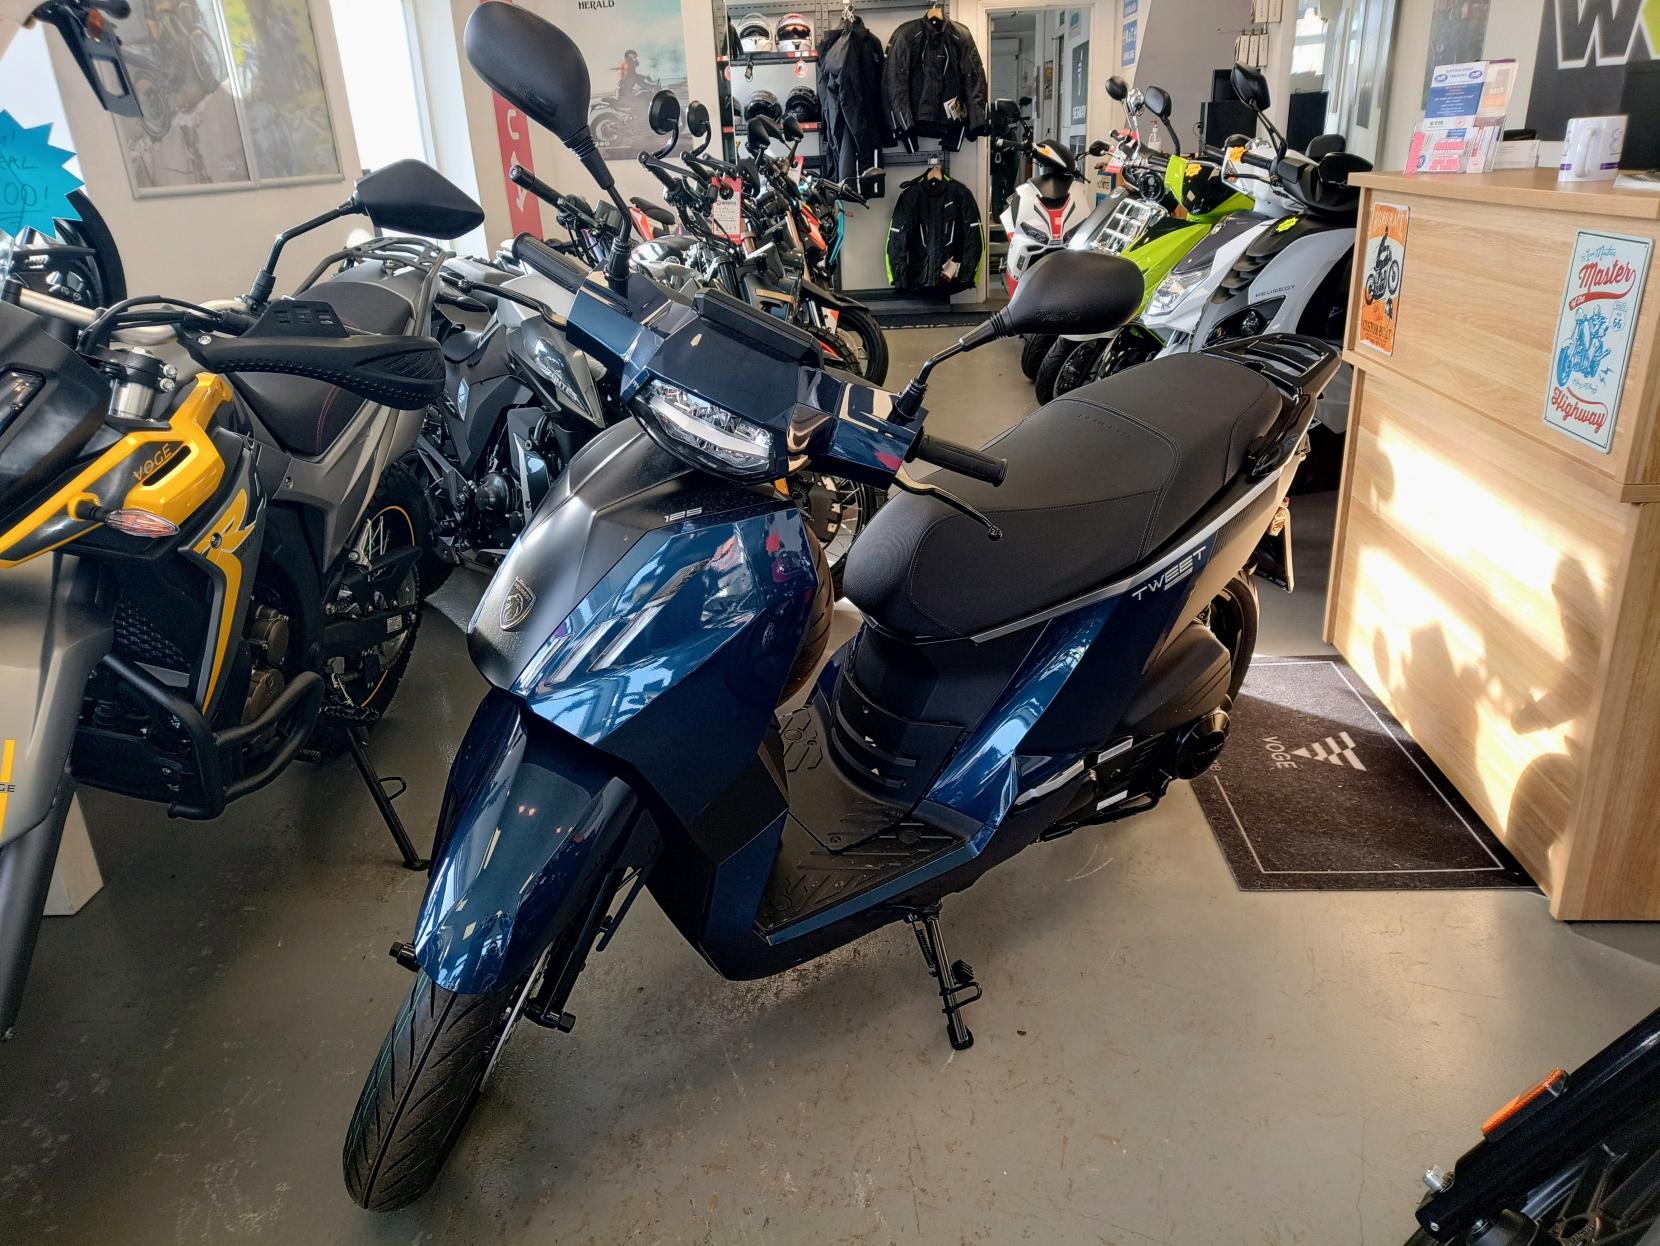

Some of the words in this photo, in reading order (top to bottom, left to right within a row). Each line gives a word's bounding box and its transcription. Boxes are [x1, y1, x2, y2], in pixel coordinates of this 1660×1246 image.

[1255, 284, 1296, 298] PEUGEOT
[1579, 260, 1634, 291] Master
[1552, 386, 1606, 433] Highway
[133, 443, 172, 480] VOGE
[663, 507, 702, 523] 125
[1132, 545, 1206, 601] TWEET
[1262, 736, 1298, 769] VOGE
